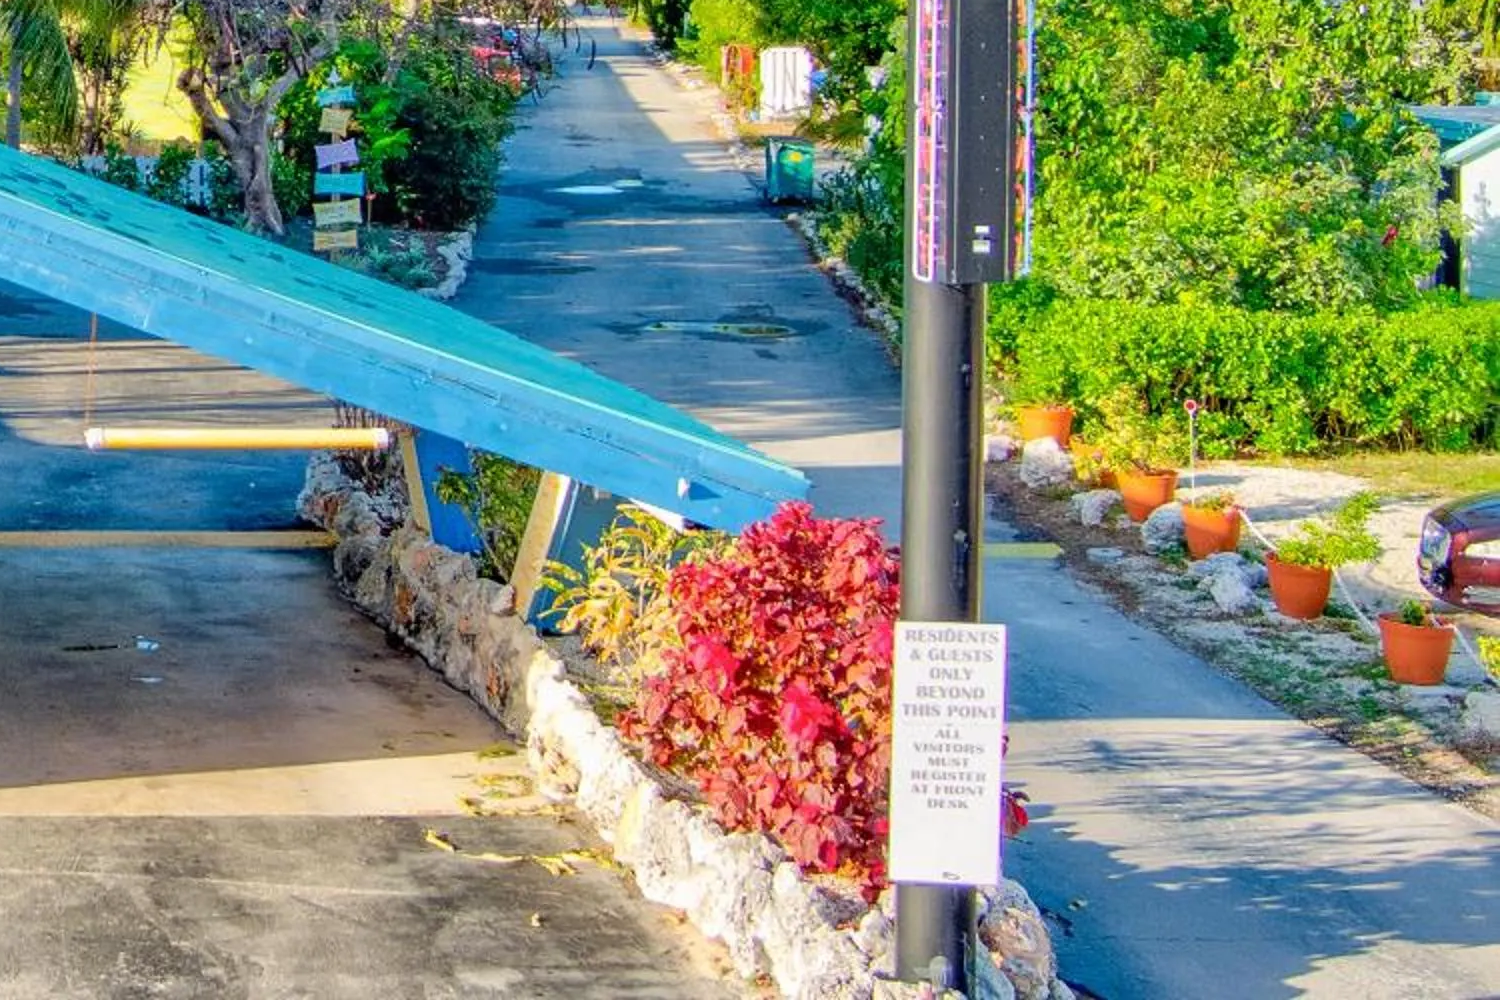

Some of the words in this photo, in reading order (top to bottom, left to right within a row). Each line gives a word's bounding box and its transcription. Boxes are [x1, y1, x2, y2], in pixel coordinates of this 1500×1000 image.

[905, 629, 999, 643] RESIDENTS
[910, 648, 921, 661] &
[928, 648, 994, 662] GUESTS
[929, 667, 973, 680] ONLY
[916, 685, 985, 699] BEYOND
[902, 703, 941, 717] THIS
[947, 704, 997, 718] POINT
[934, 729, 962, 739] ALL
[913, 742, 985, 754] VISITORS
[928, 757, 970, 767] MUST
[911, 770, 986, 782] REGISTER
[911, 784, 928, 794] AT
[935, 785, 985, 796] FRONT
[927, 798, 968, 809] DESK
